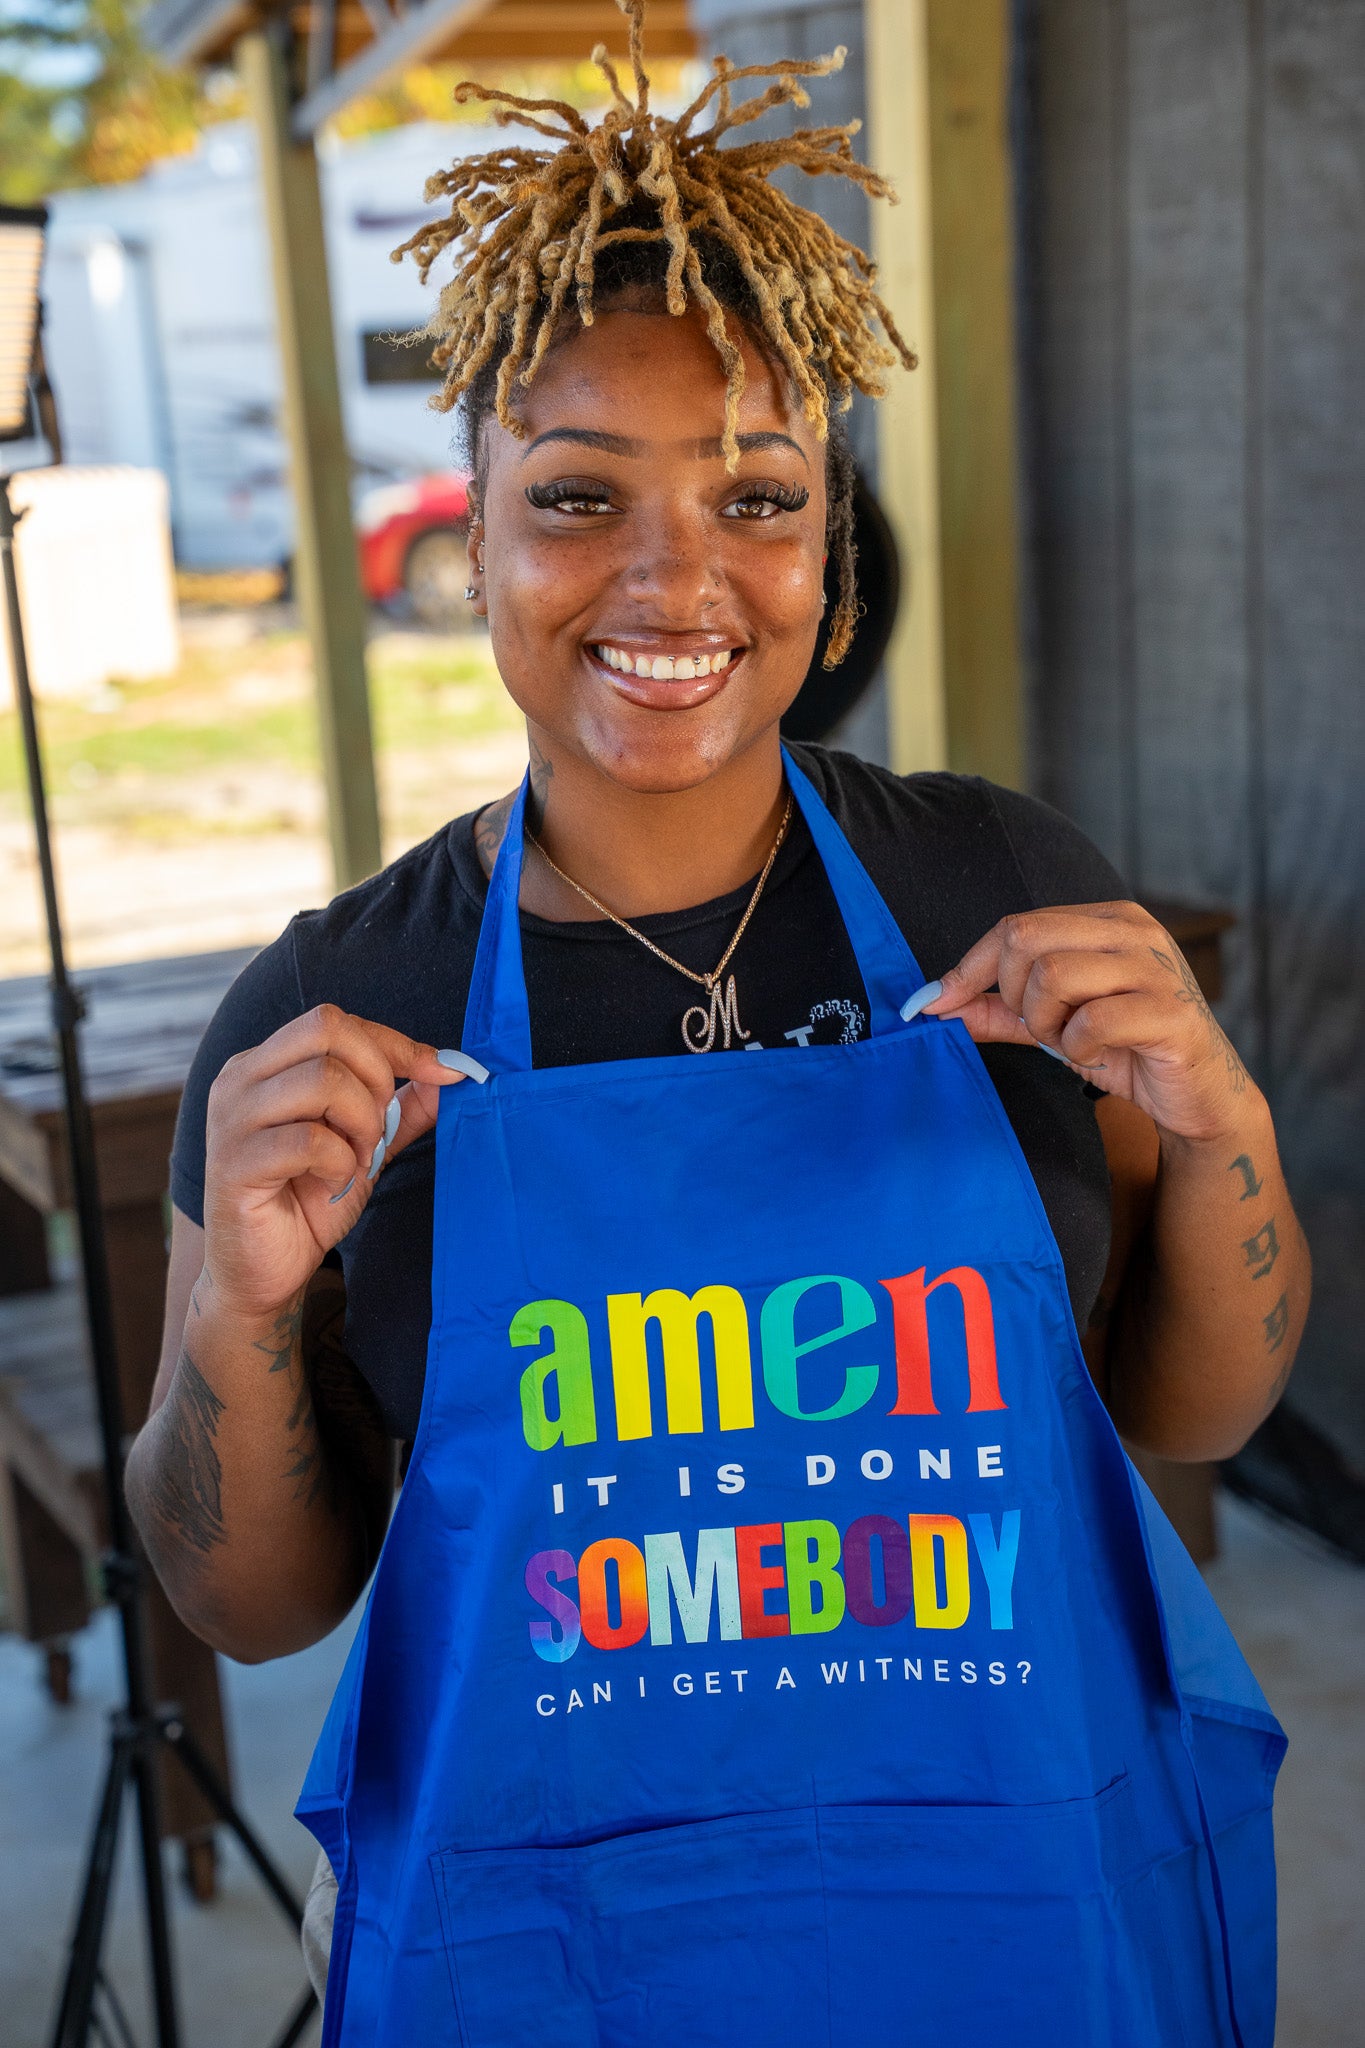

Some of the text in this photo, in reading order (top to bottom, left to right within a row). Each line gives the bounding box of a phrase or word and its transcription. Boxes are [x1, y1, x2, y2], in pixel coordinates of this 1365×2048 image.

[509, 1265, 1009, 1451] amen
[553, 1445, 1004, 1514] IT IS DONE
[525, 1509, 1021, 1663] SOMEBODY
[536, 1658, 1032, 1716] CAN I GET A WITNESS?
